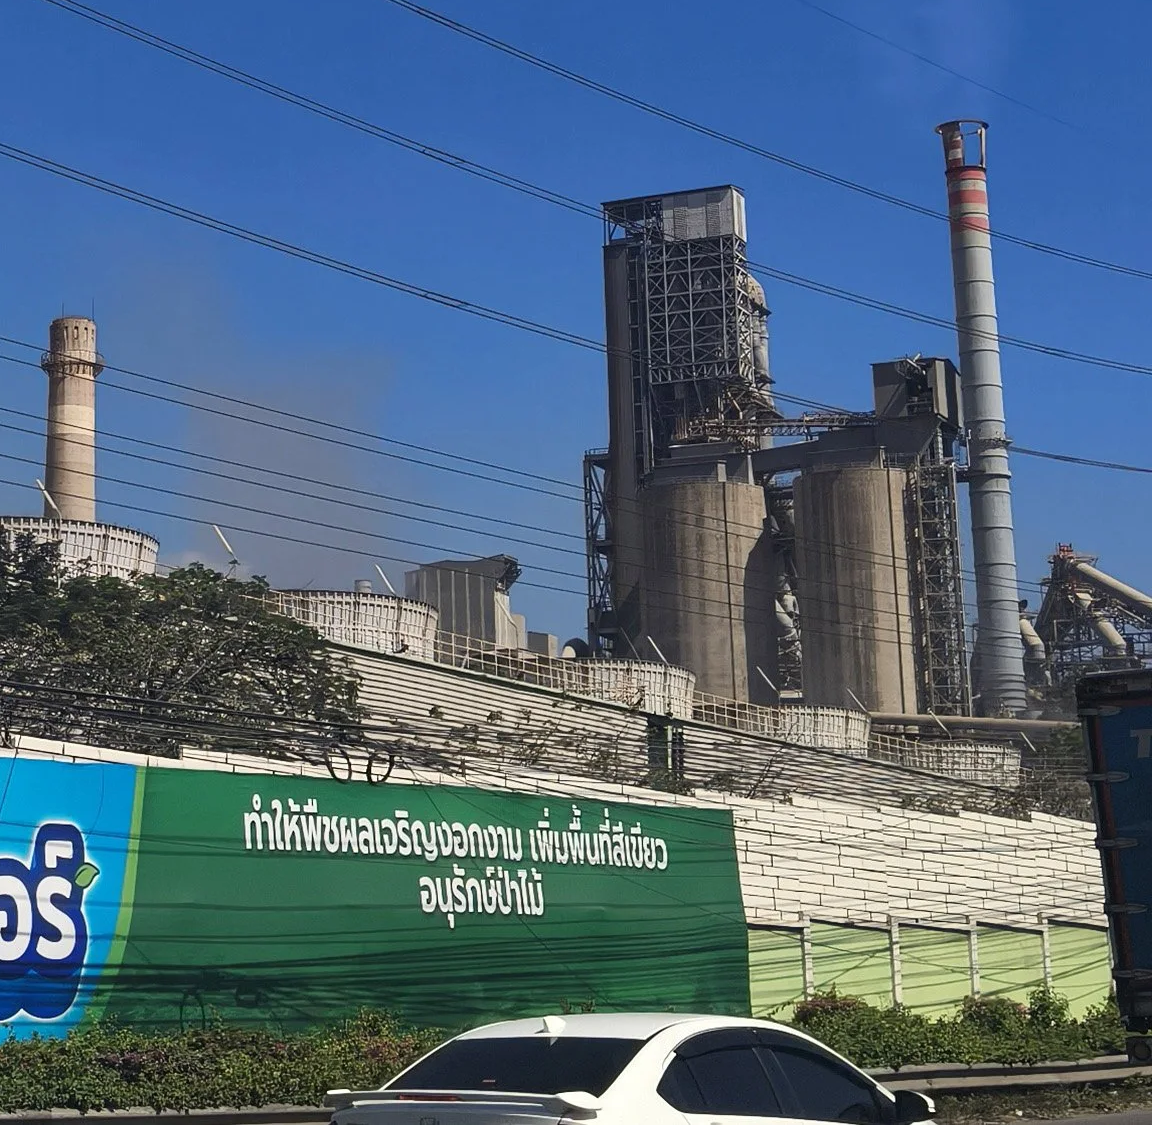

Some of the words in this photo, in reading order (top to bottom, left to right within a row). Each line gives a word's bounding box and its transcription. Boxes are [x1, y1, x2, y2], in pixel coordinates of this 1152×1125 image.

[243, 793, 523, 862] ทำให้พืชผลเจริญงอกงาม
[529, 804, 668, 870] เพิ่มพื้นที่สีเขียว
[419, 863, 544, 929] อนุรักษ์ป่าไม้
